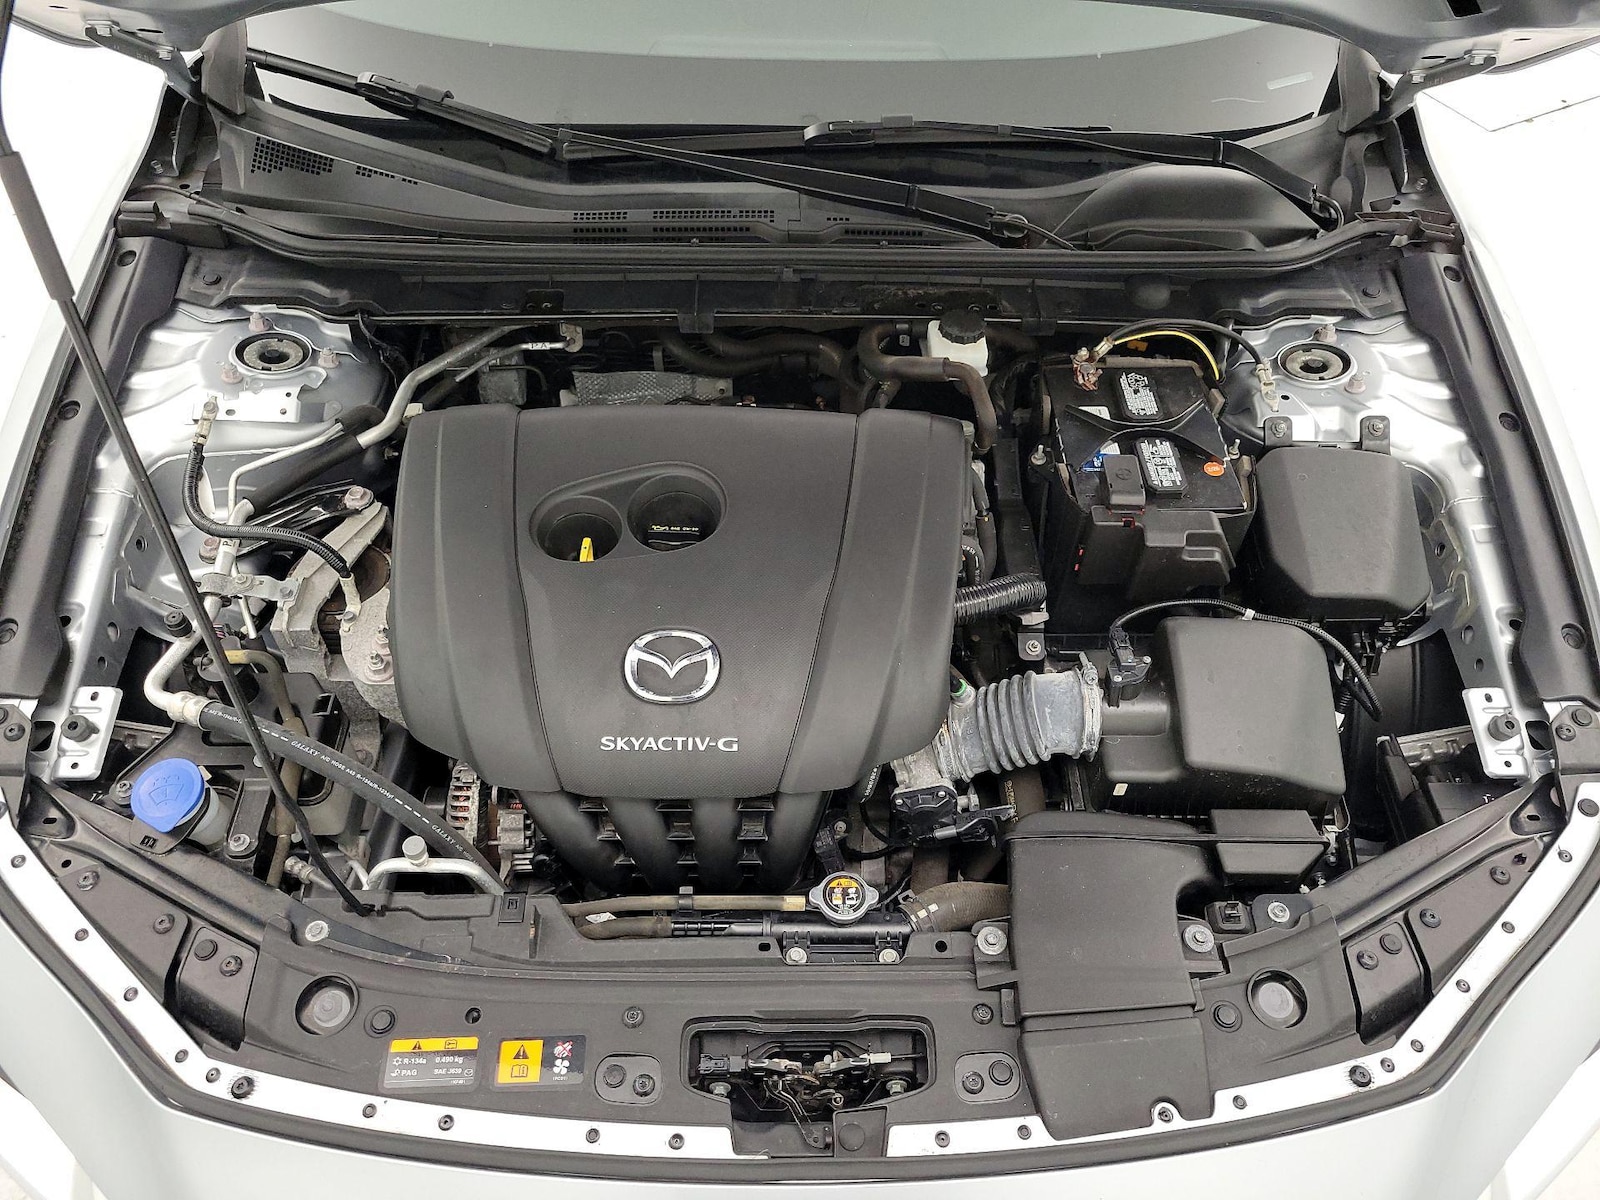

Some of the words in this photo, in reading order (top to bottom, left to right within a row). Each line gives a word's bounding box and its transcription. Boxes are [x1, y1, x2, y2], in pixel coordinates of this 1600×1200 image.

[600, 736, 739, 752] SKYACTIV-G
[291, 741, 320, 756] GALAXY
[331, 760, 346, 770] HOSE
[431, 824, 456, 845] GALAXY
[403, 1057, 427, 1065] R-134a
[435, 1056, 454, 1064] 0.490
[454, 1055, 464, 1064] kg
